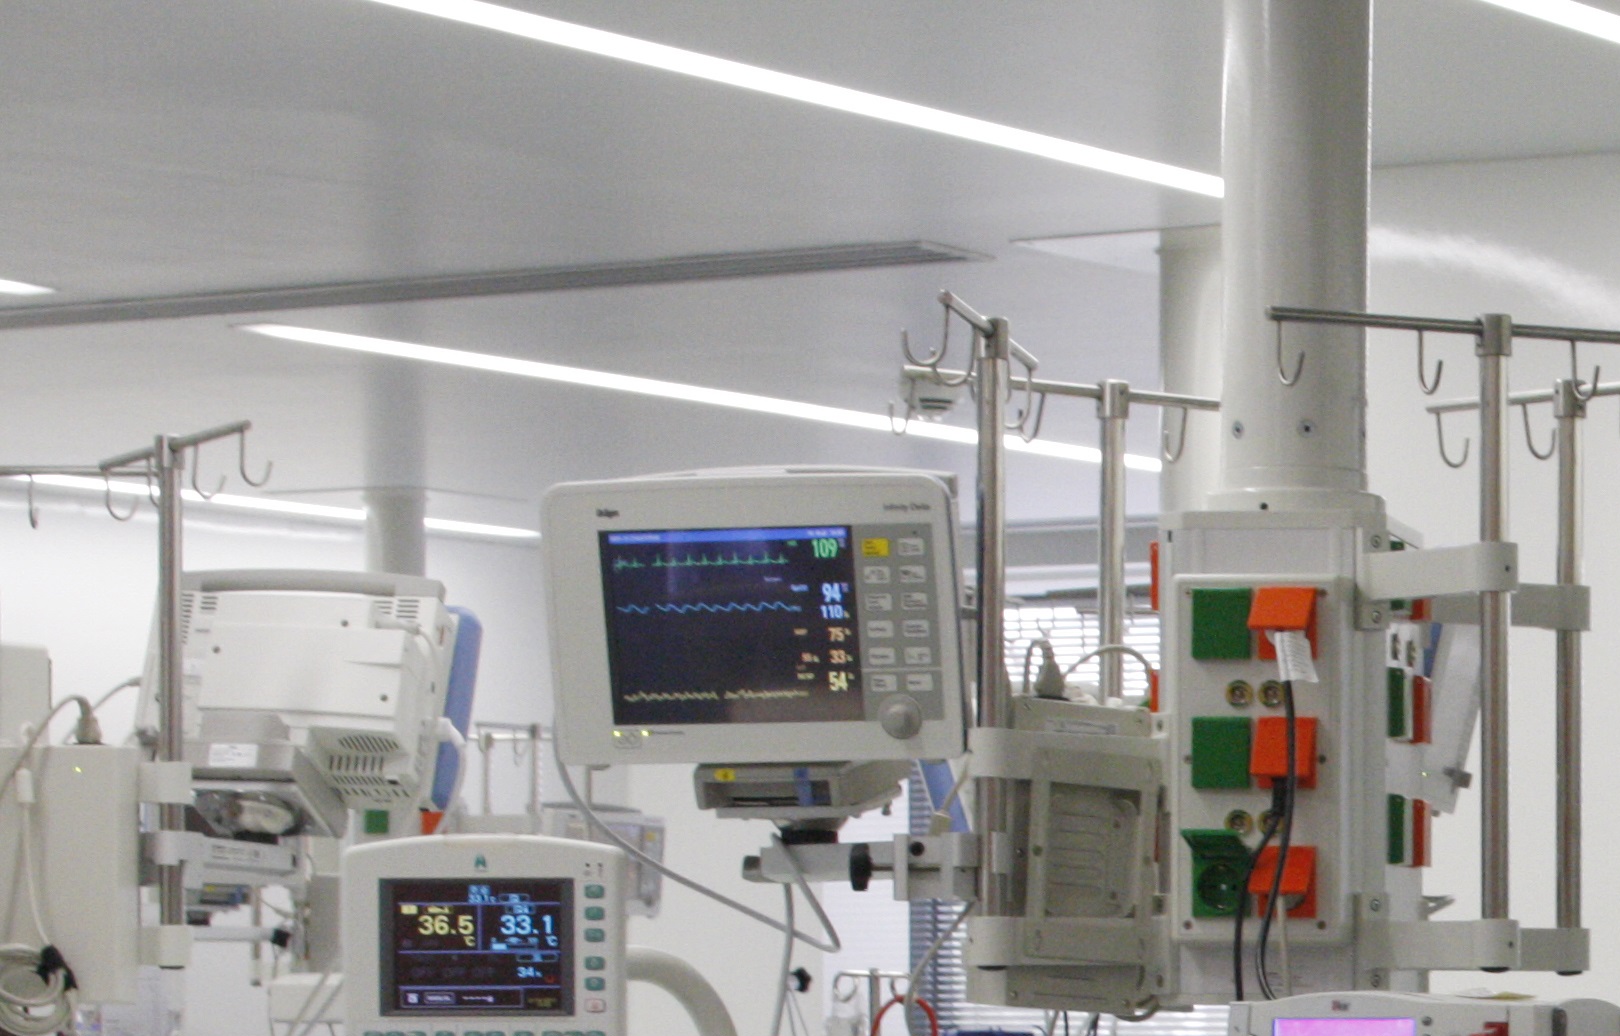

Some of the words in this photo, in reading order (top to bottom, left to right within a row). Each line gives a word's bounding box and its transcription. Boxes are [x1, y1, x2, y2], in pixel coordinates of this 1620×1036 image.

[811, 538, 839, 558] 109
[821, 582, 842, 603] 94
[820, 604, 843, 619] 110
[828, 671, 848, 691] 54
[418, 914, 474, 935] 36.5
[500, 914, 553, 935] 33.1
